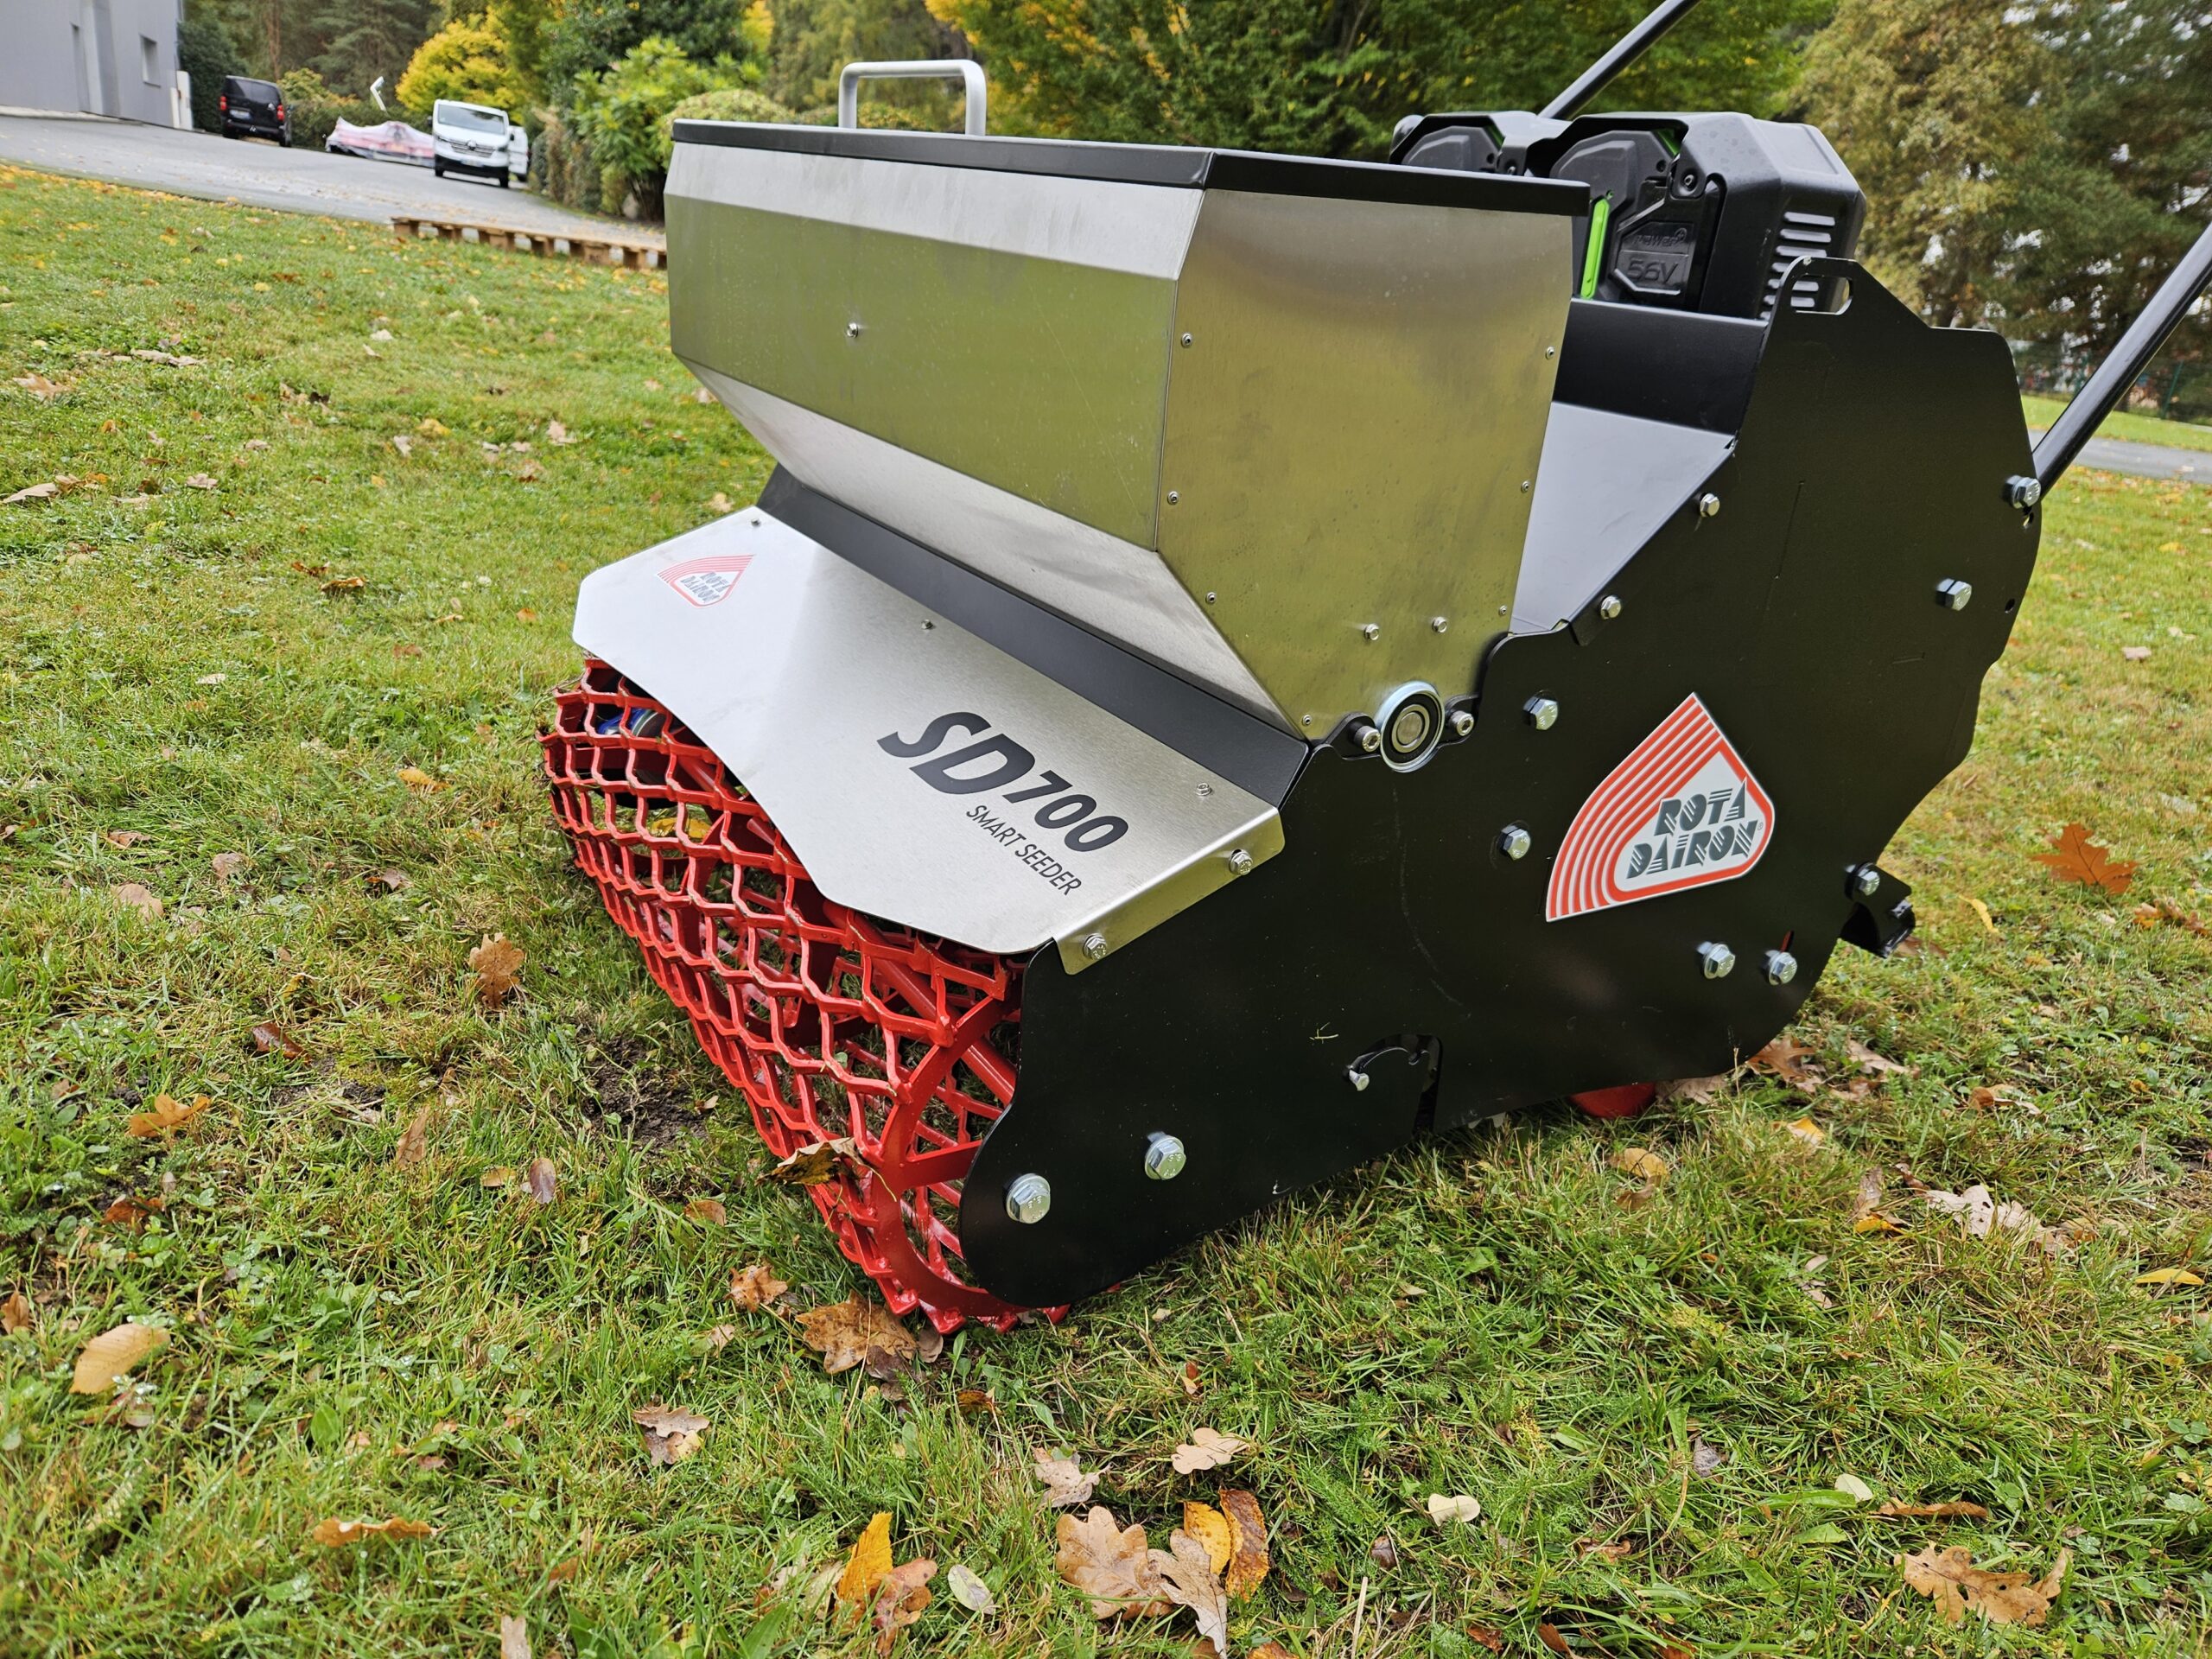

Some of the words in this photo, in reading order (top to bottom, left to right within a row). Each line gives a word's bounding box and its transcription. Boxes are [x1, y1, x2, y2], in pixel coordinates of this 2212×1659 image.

[1628, 258, 1679, 284] 56V
[1654, 780, 1746, 836] ROTA
[966, 804, 1027, 847] SMART
[1014, 843, 1082, 896] SEEDER
[1626, 819, 1758, 880] DAIRON
